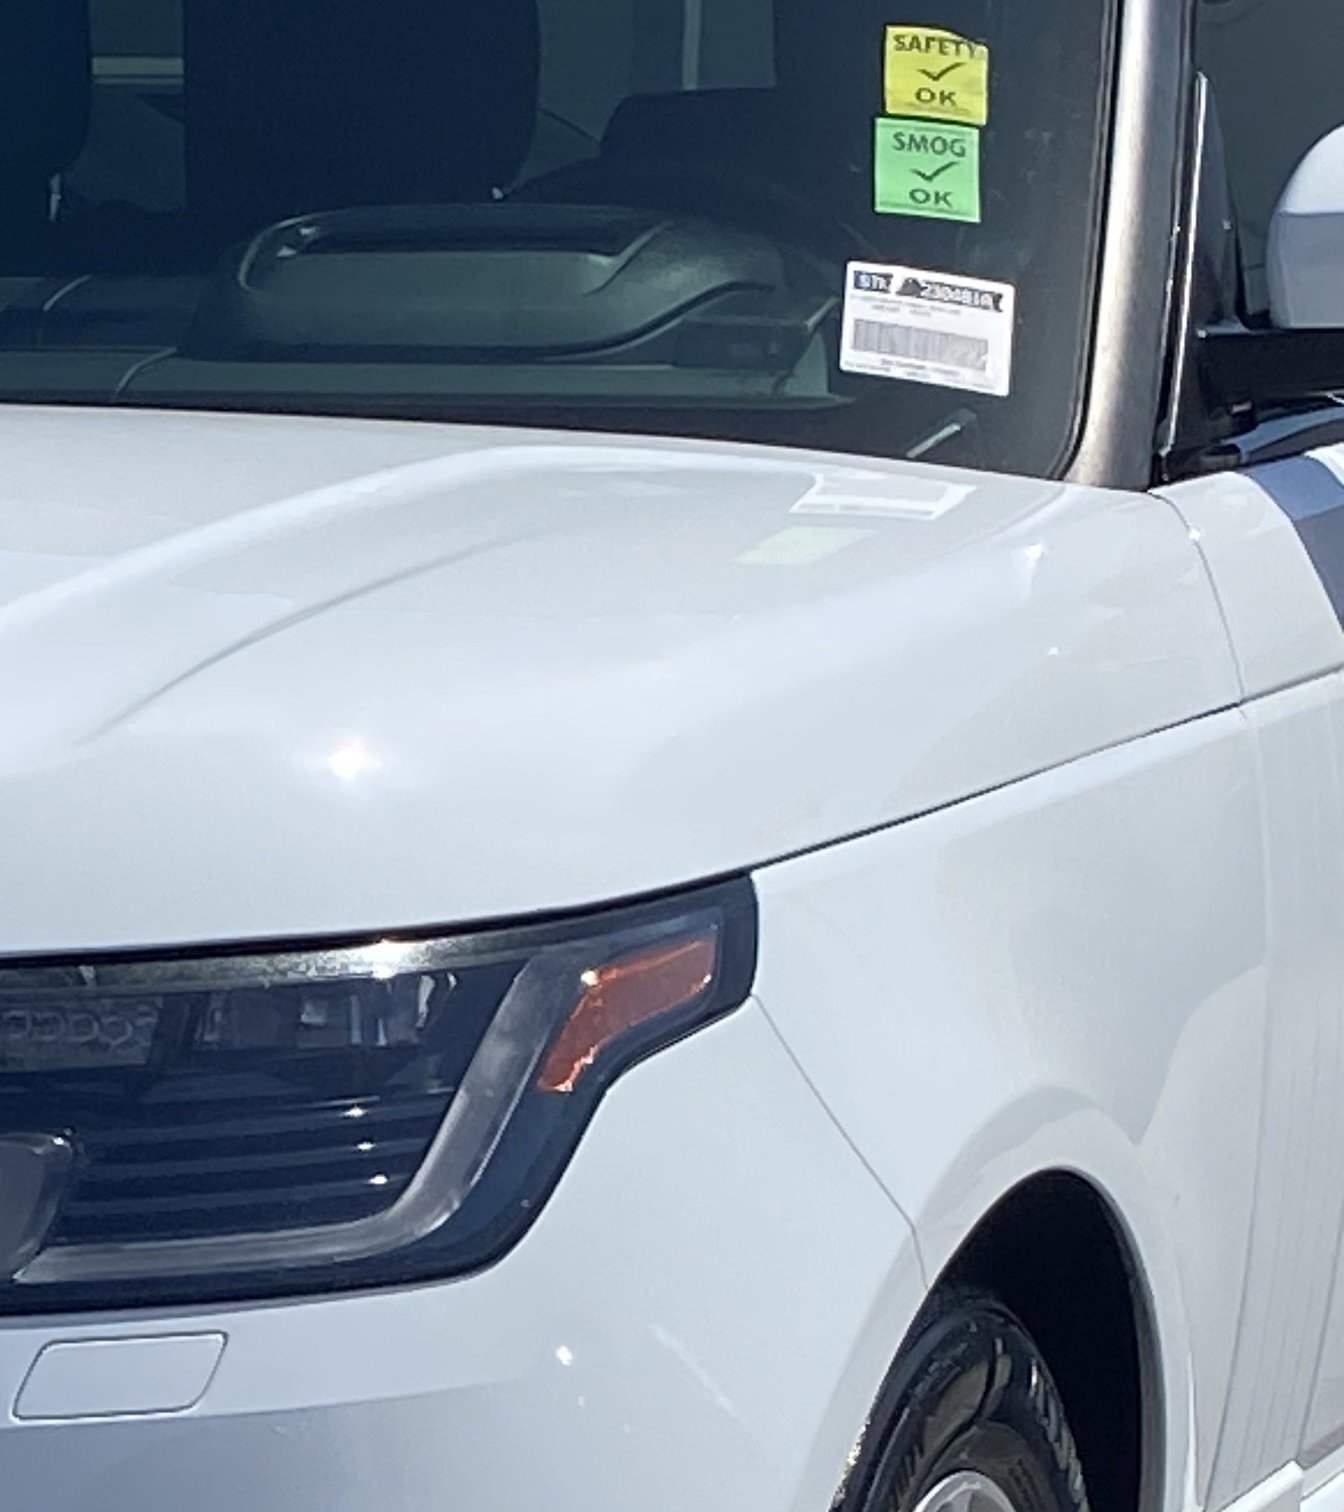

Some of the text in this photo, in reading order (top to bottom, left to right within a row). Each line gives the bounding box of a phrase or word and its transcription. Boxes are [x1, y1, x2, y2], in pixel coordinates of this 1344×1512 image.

[893, 34, 977, 60] SAFETY
[915, 87, 957, 107] OK
[892, 131, 967, 158] SMOG
[908, 188, 954, 208] OK
